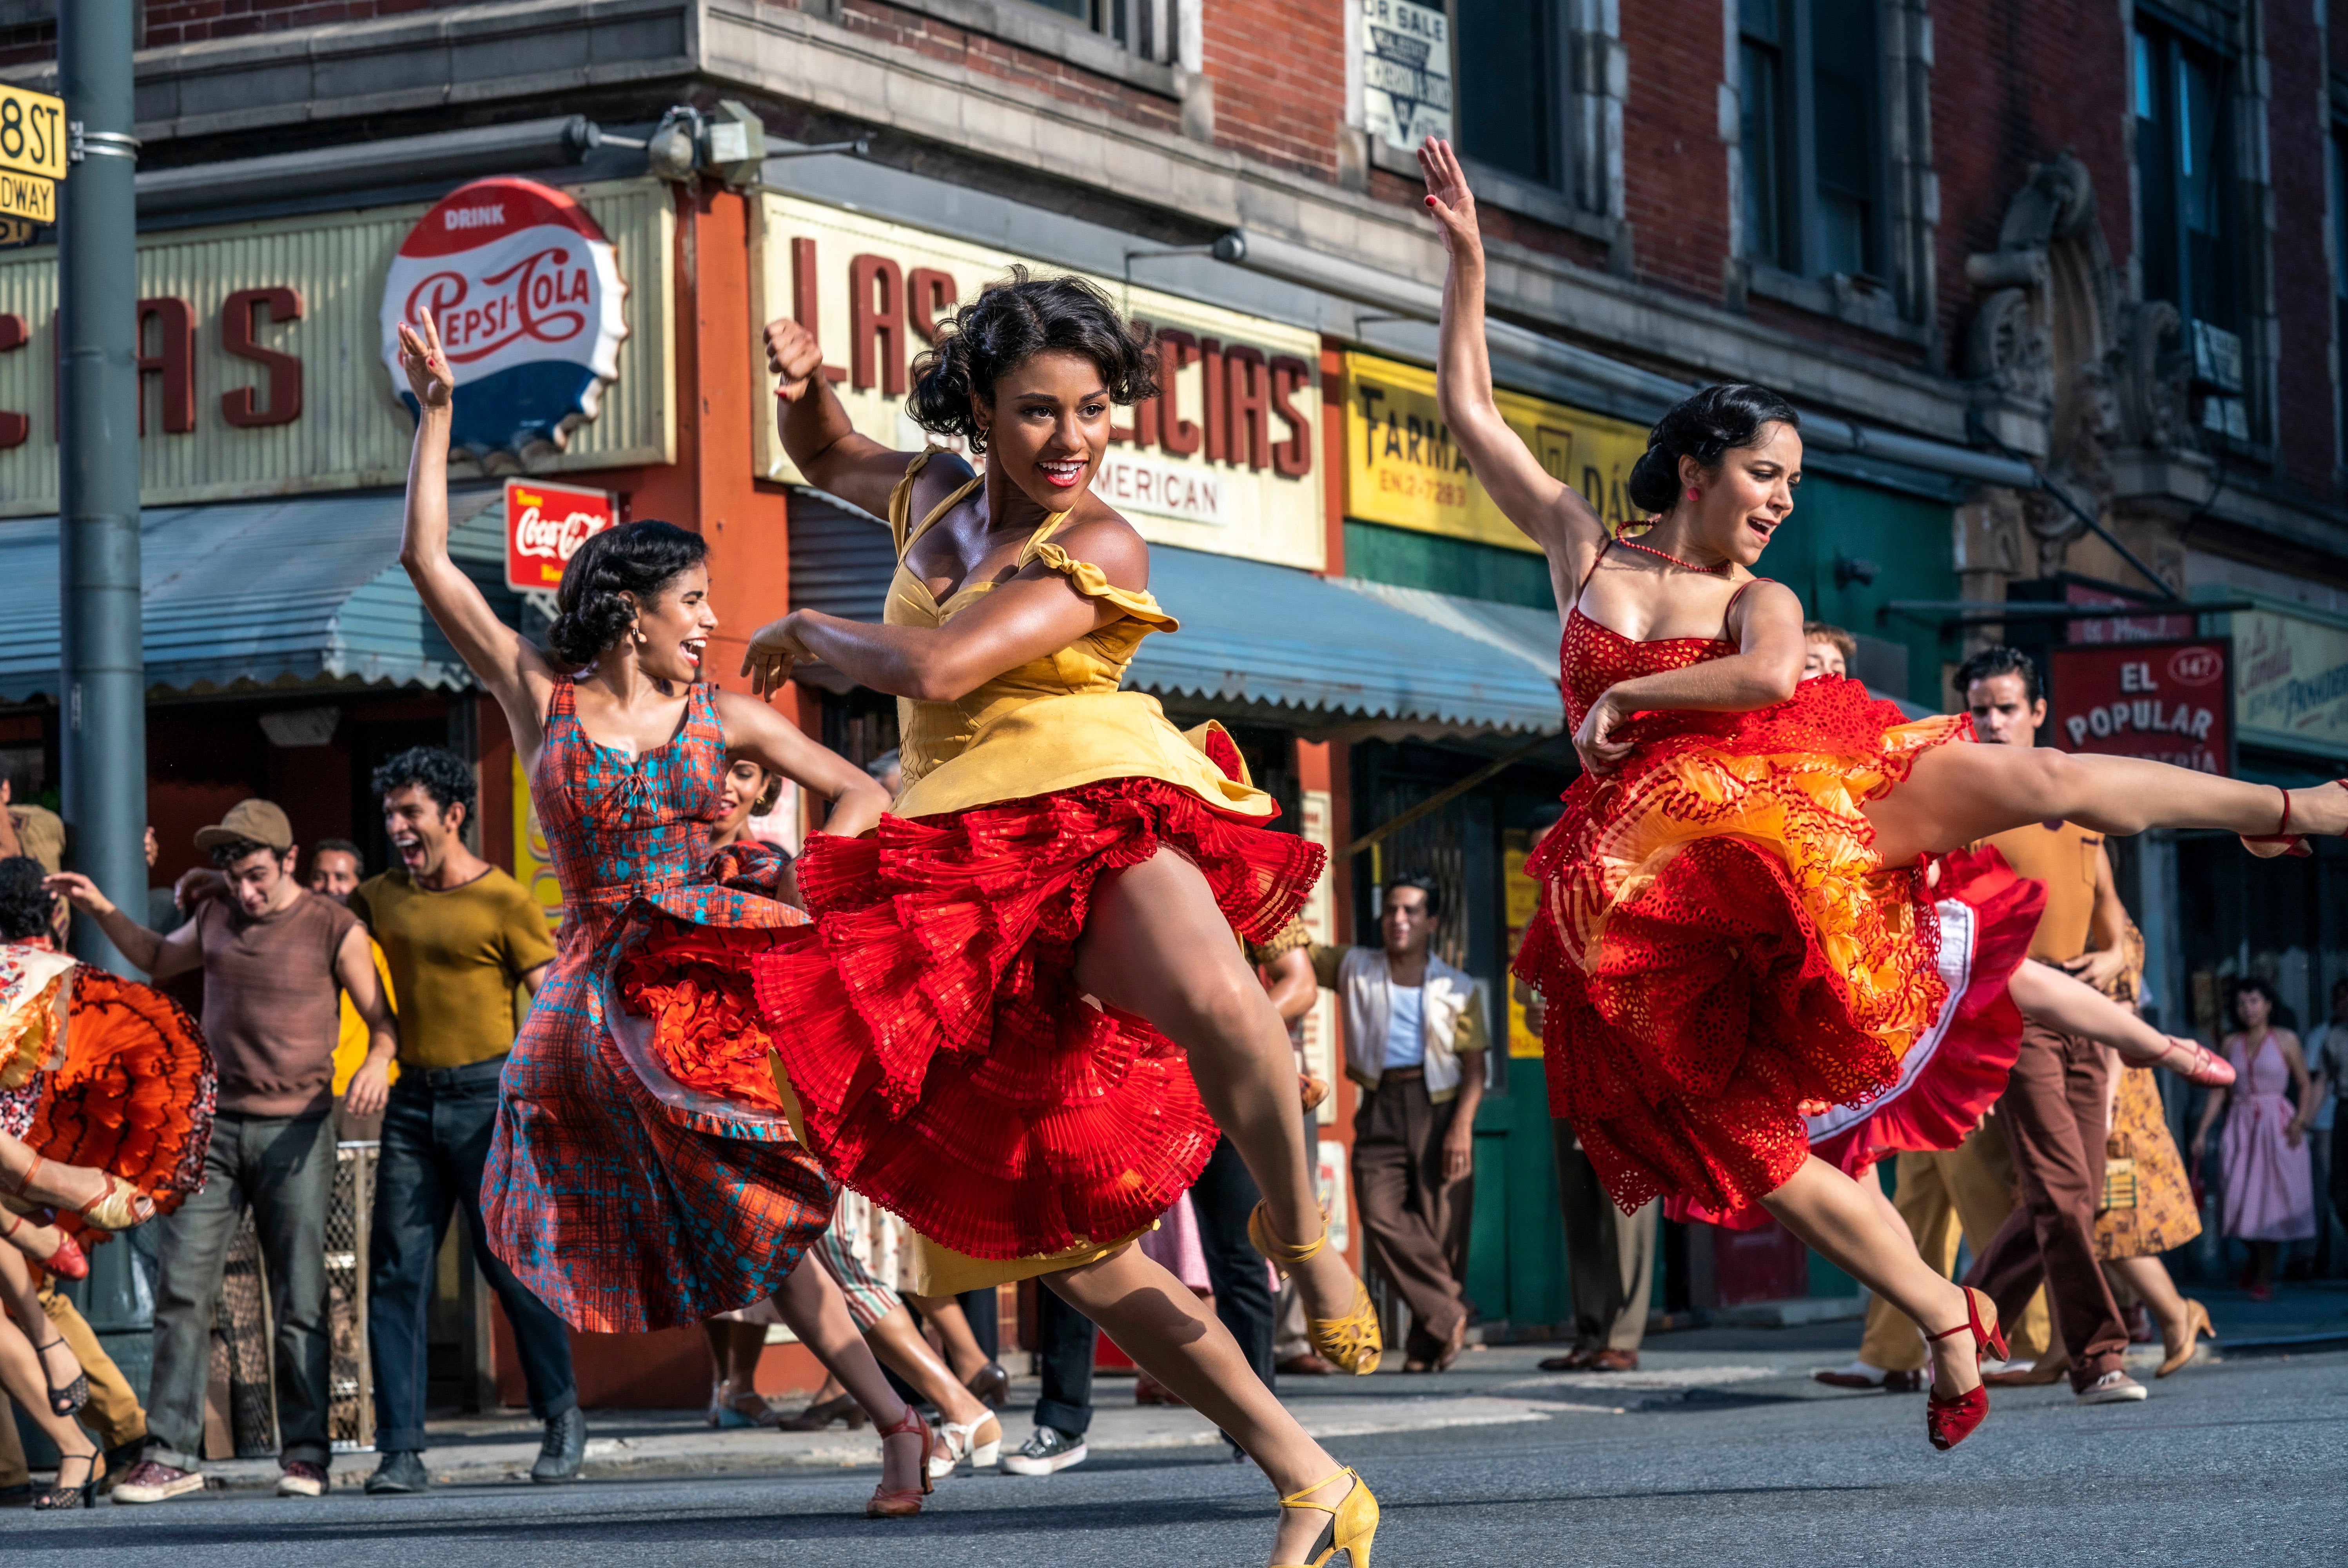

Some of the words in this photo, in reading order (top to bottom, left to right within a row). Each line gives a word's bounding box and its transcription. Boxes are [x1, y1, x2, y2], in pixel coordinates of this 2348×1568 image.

[445, 204, 506, 230] DRINK
[791, 237, 957, 395] LAS
[1094, 462, 1216, 513] MERICAN
[2121, 661, 2158, 692] EL
[2066, 700, 2213, 746] POPULAR
